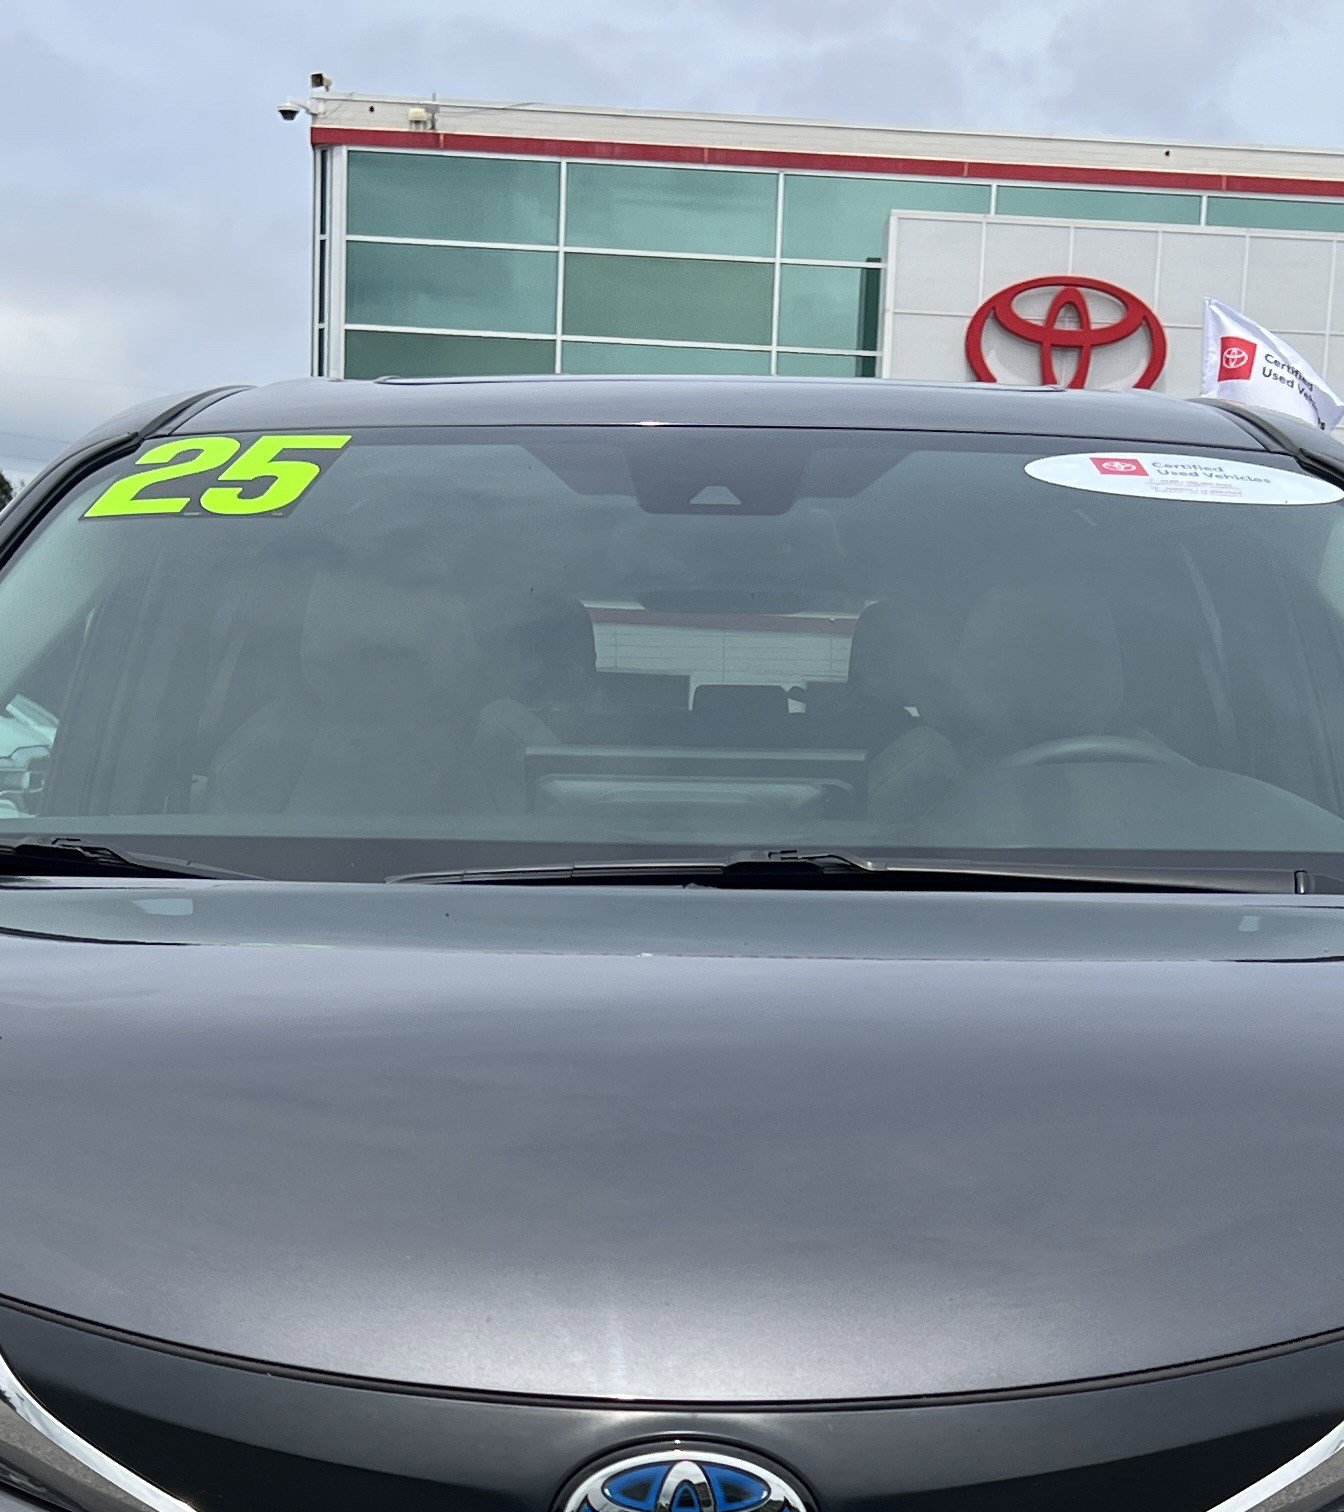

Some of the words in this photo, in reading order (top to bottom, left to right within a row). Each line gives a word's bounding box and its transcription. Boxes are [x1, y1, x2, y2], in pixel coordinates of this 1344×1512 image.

[1262, 366, 1294, 388] Used
[84, 435, 352, 517] 25
[1152, 461, 1224, 473] Certified
[1157, 469, 1199, 477] Used
[1204, 472, 1272, 484] Vehicles
